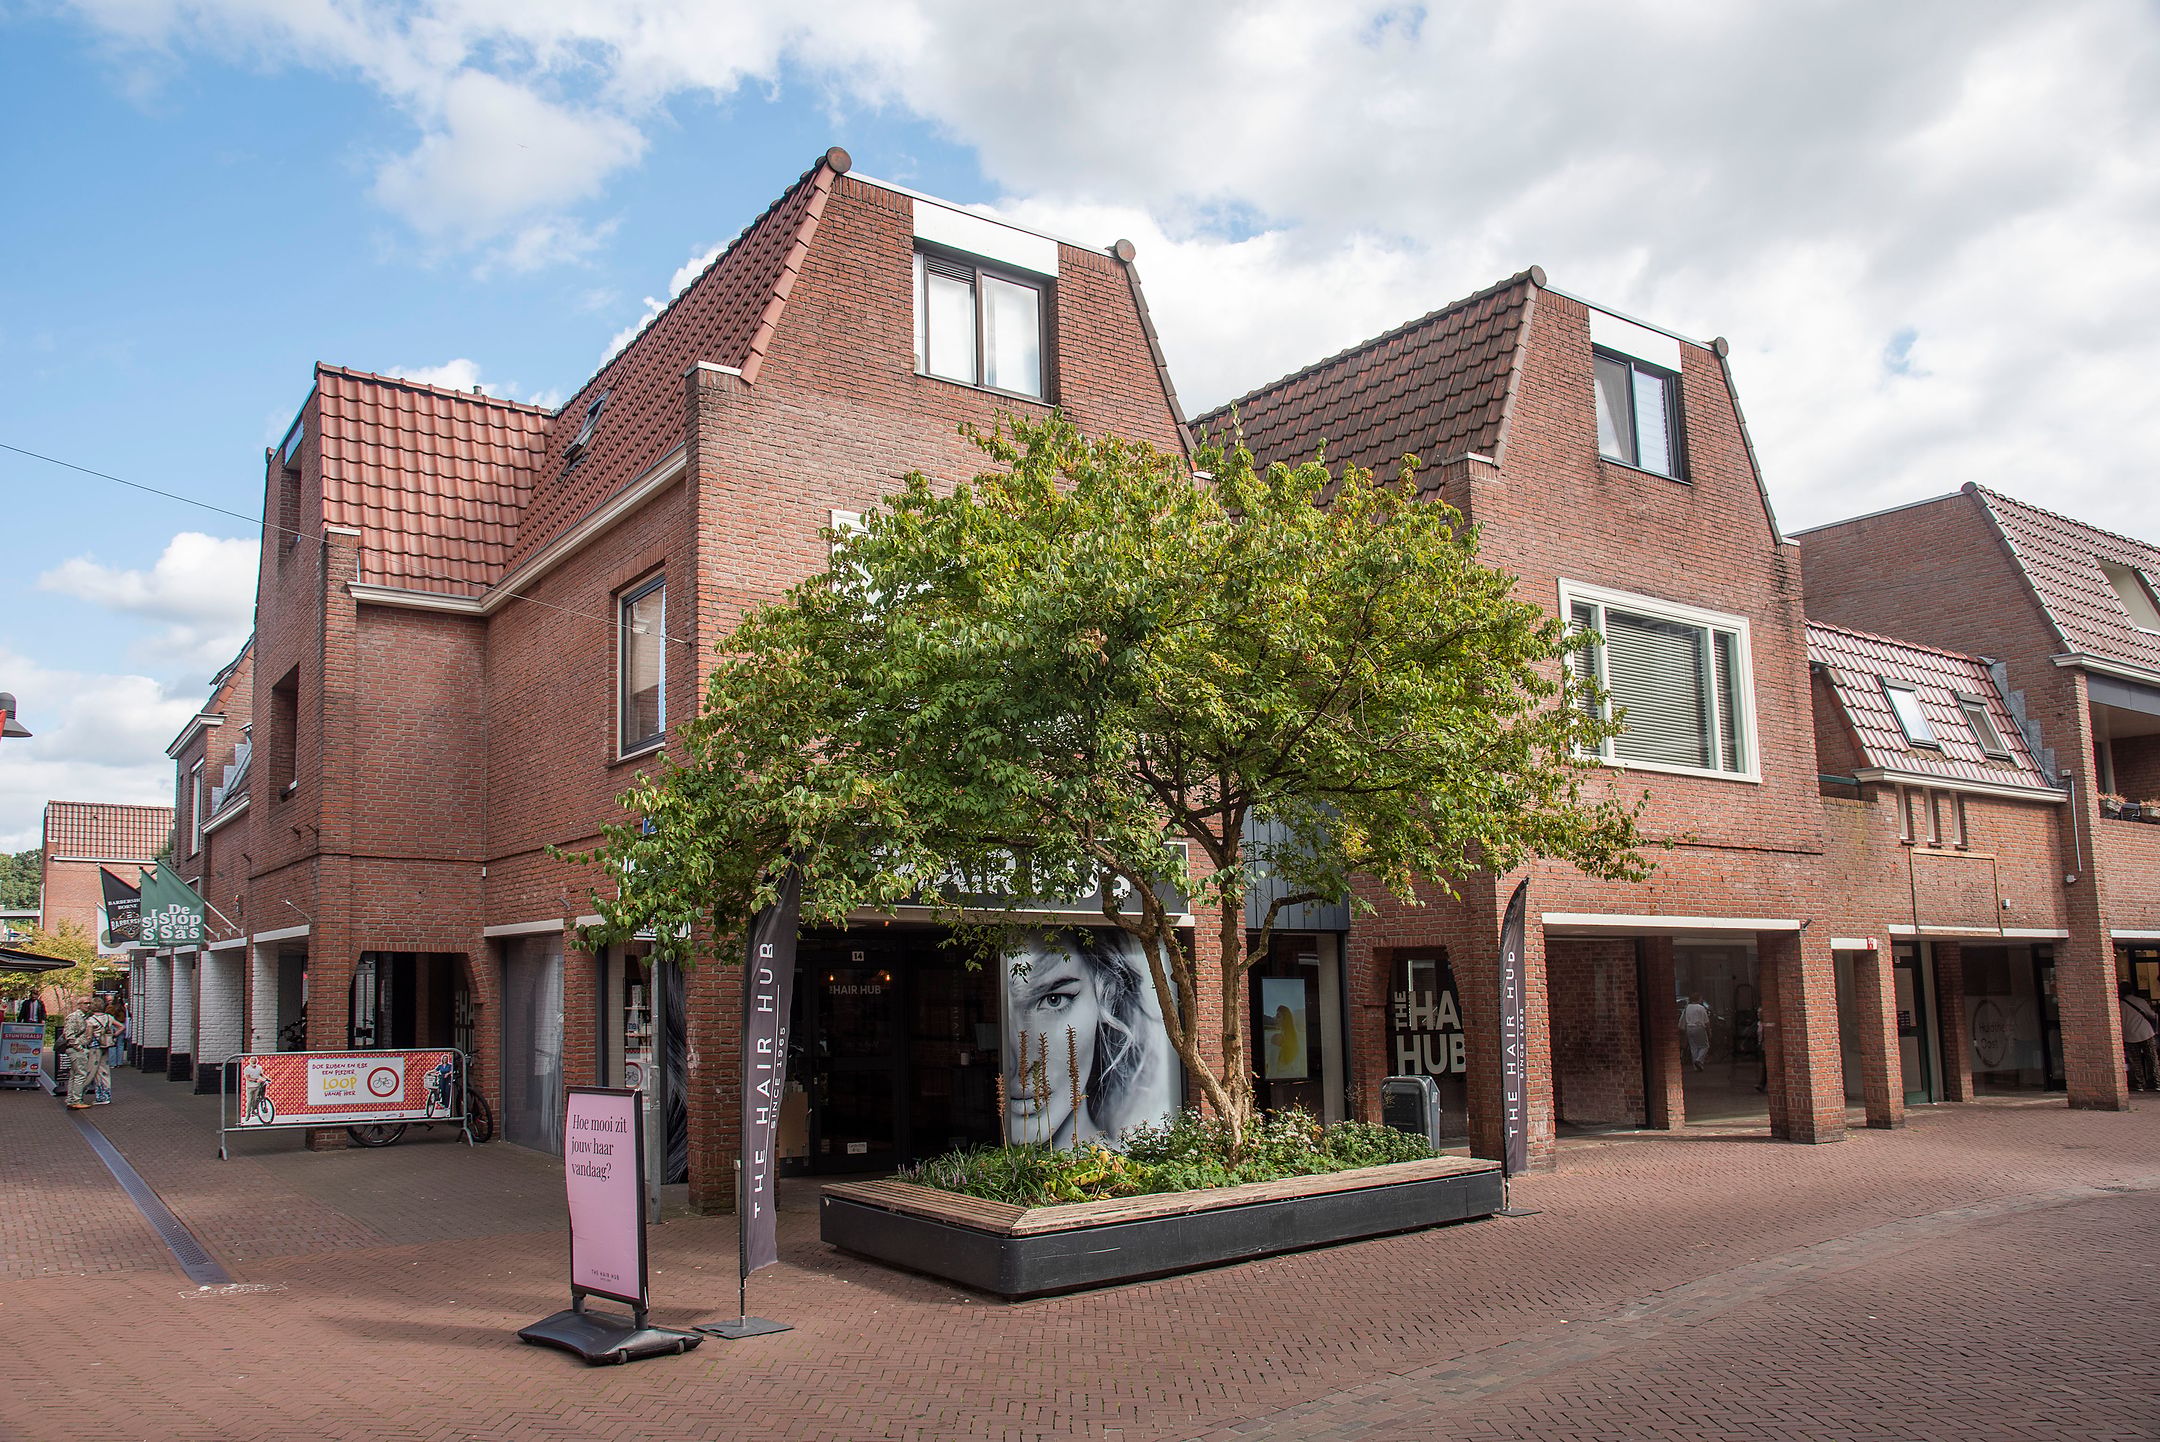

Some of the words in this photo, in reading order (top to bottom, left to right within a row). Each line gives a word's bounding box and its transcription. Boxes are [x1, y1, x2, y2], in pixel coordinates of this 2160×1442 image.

[159, 912, 202, 927] Sjop
[168, 904, 190, 914] De
[160, 925, 200, 939] Sas
[853, 952, 863, 960] 14
[757, 943, 773, 1013] HUB
[833, 985, 858, 995] HAIR
[860, 985, 881, 995] HUB
[1394, 990, 1408, 1031] THE
[1396, 1033, 1466, 1076] HUB
[1506, 1015, 1517, 1075] HAIR
[323, 1077, 357, 1091] LOOP
[756, 1037, 772, 1125] HAIR
[771, 1078, 780, 1129] SINCE
[777, 1027, 786, 1068] 1965
[572, 1114, 589, 1131] Hoe
[590, 1116, 613, 1132] mooi
[615, 1116, 628, 1133] zit
[1507, 1091, 1518, 1138] THE
[571, 1136, 592, 1155] jouw
[593, 1137, 614, 1156] haar
[571, 1160, 612, 1182] vandaag?
[754, 1150, 766, 1219] THE
